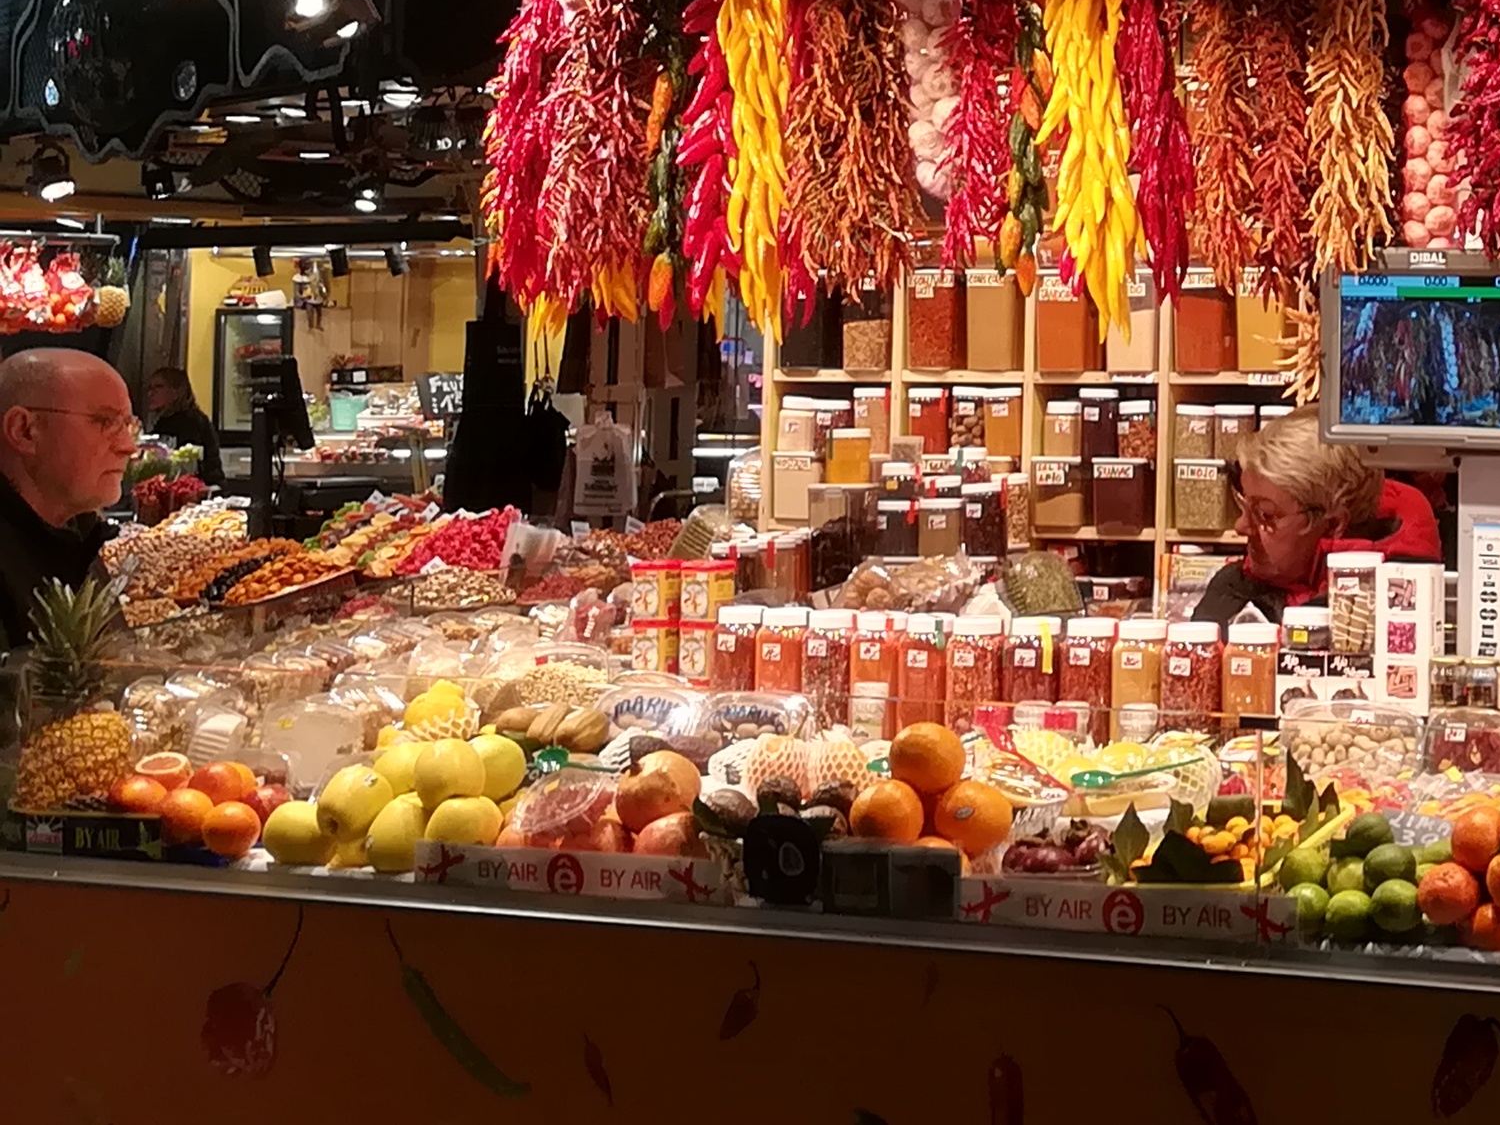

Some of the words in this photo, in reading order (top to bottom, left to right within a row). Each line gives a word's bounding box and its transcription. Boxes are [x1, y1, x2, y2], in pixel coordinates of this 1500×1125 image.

[1410, 251, 1446, 264] DIBAL
[75, 826, 93, 849] BY
[477, 859, 501, 879] BY
[508, 861, 539, 883] AIR
[600, 867, 627, 888] BY
[631, 869, 662, 892] AIR
[1025, 897, 1053, 918] BY
[1058, 898, 1093, 921] AIR
[1162, 904, 1192, 926] BY
[1197, 906, 1233, 929] AIR
